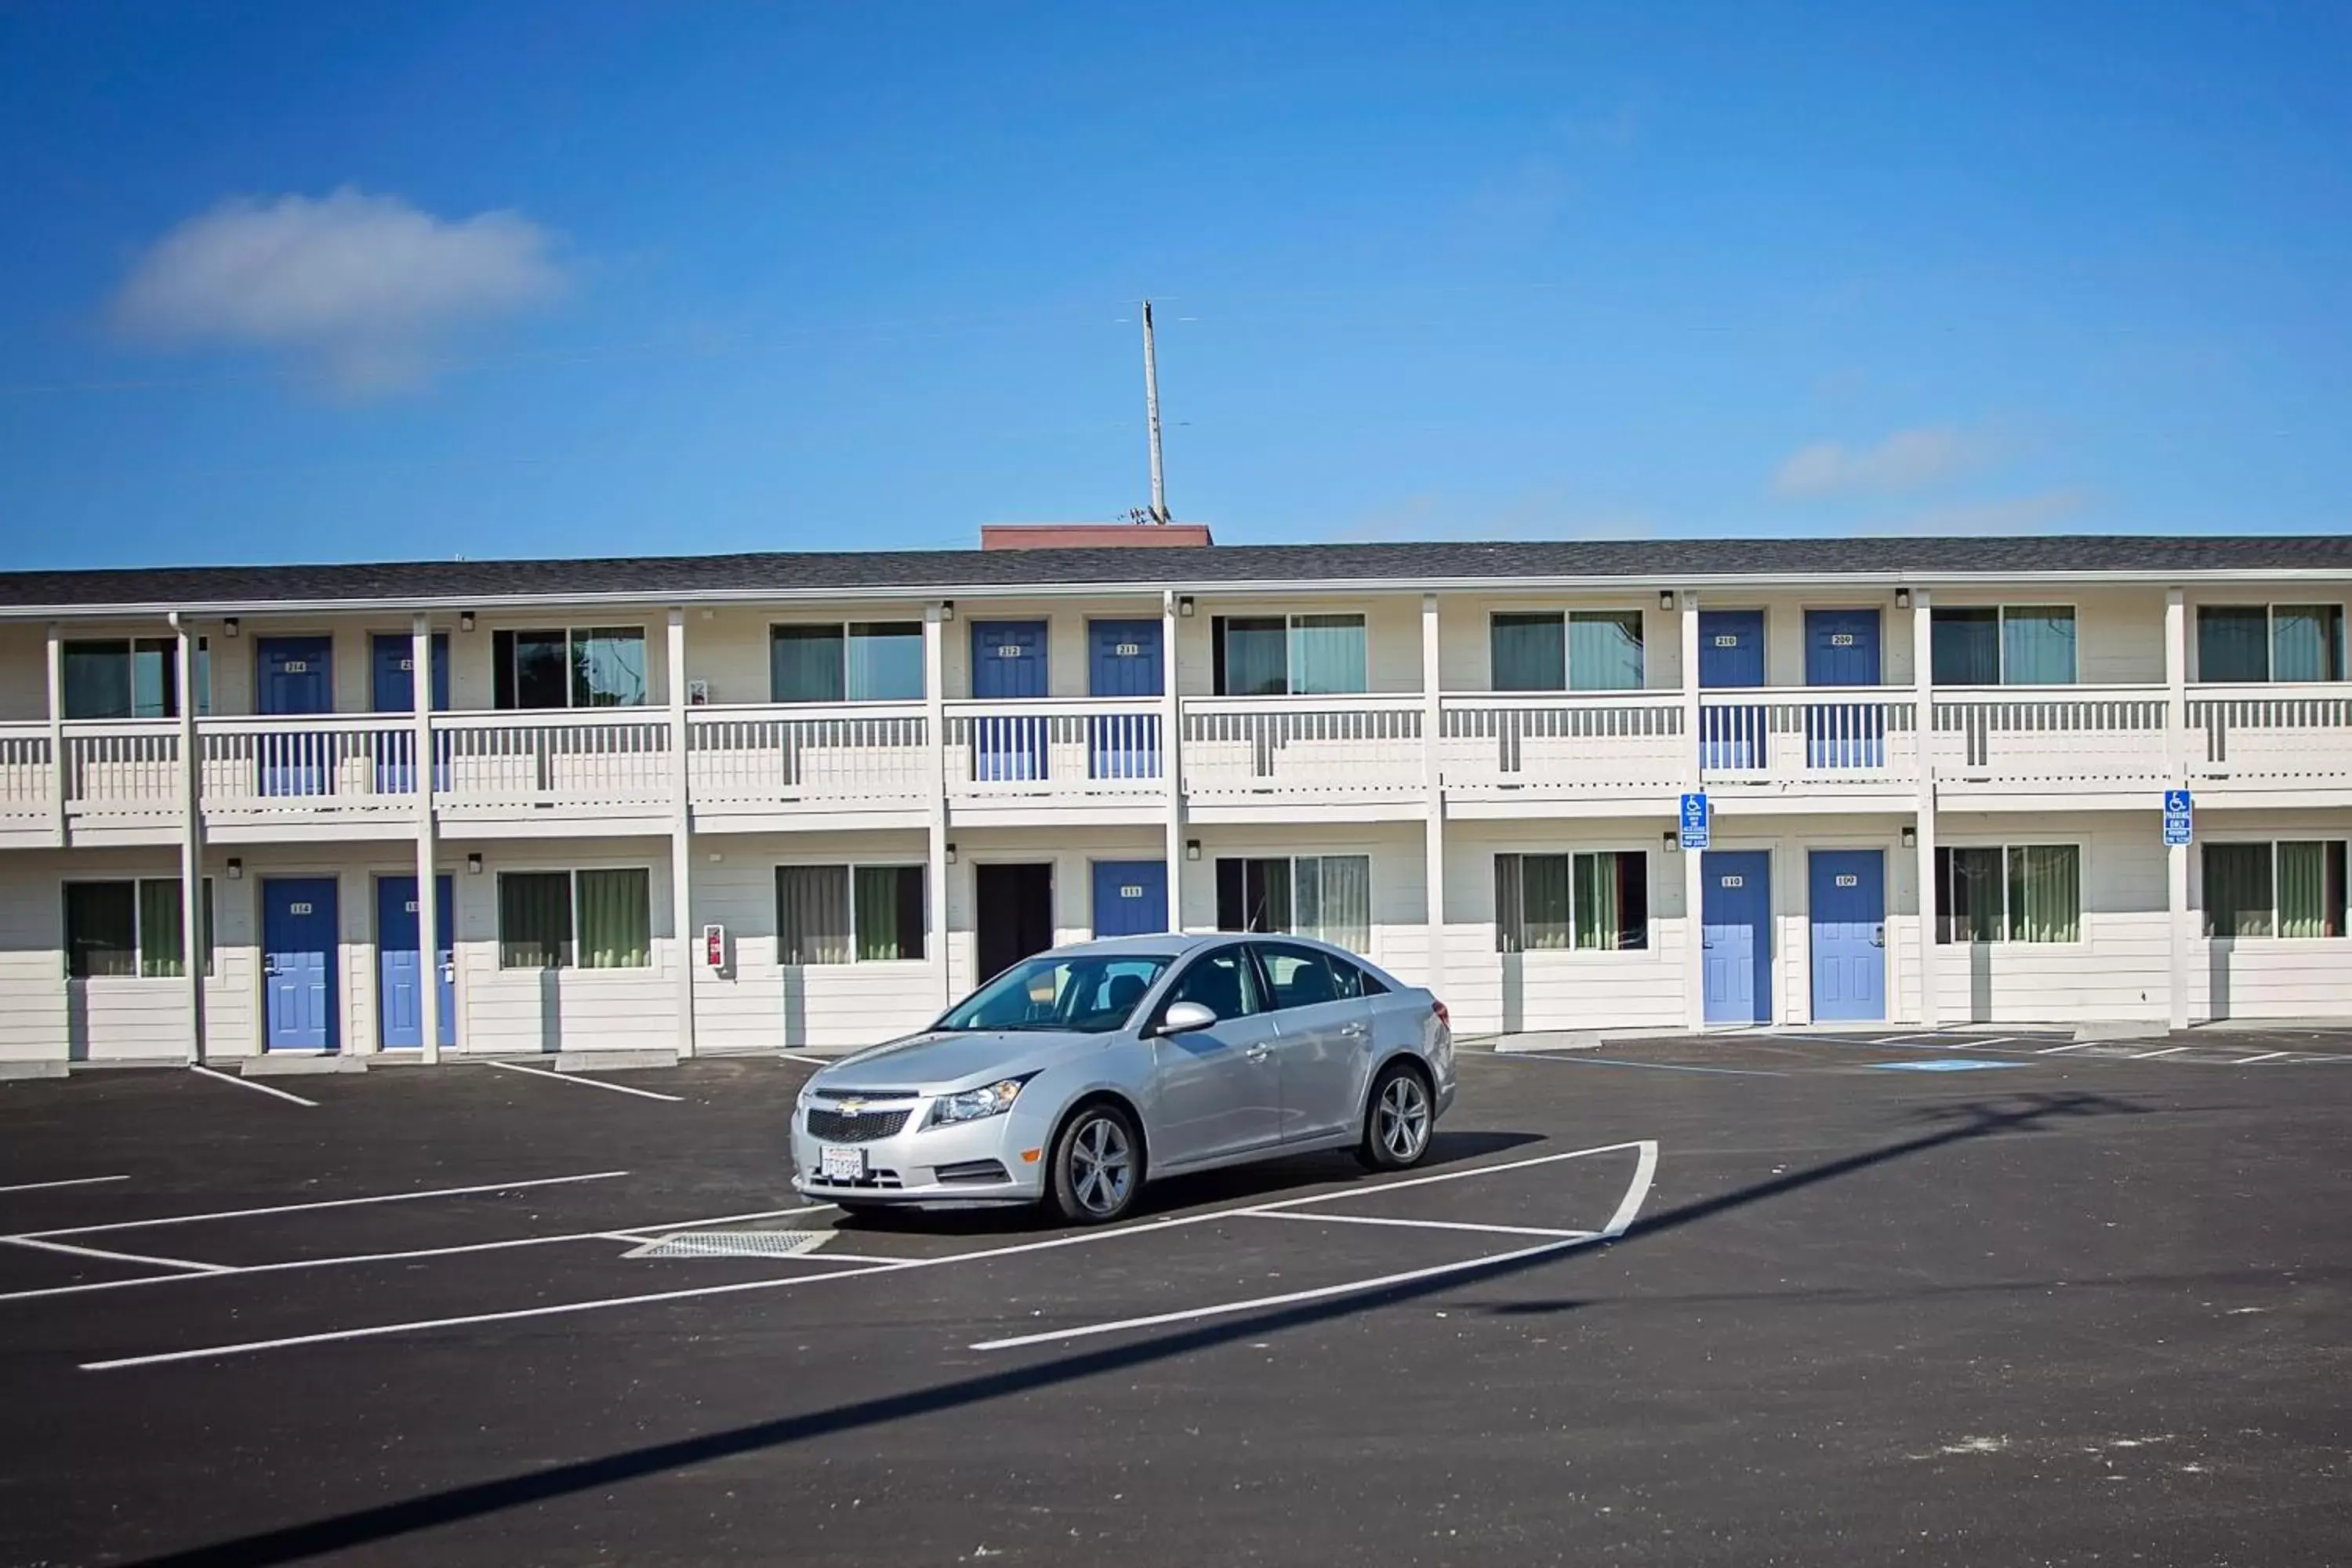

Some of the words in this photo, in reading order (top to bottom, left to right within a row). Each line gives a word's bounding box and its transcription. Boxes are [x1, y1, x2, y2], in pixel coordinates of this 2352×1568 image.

[1718, 637, 1735, 645] 210
[1001, 647, 1018, 655] 212
[1120, 644, 1135, 654] 211
[287, 663, 304, 672] 214
[1724, 877, 1740, 885] 110
[1838, 877, 1855, 885] 109
[1124, 887, 1140, 896] 111
